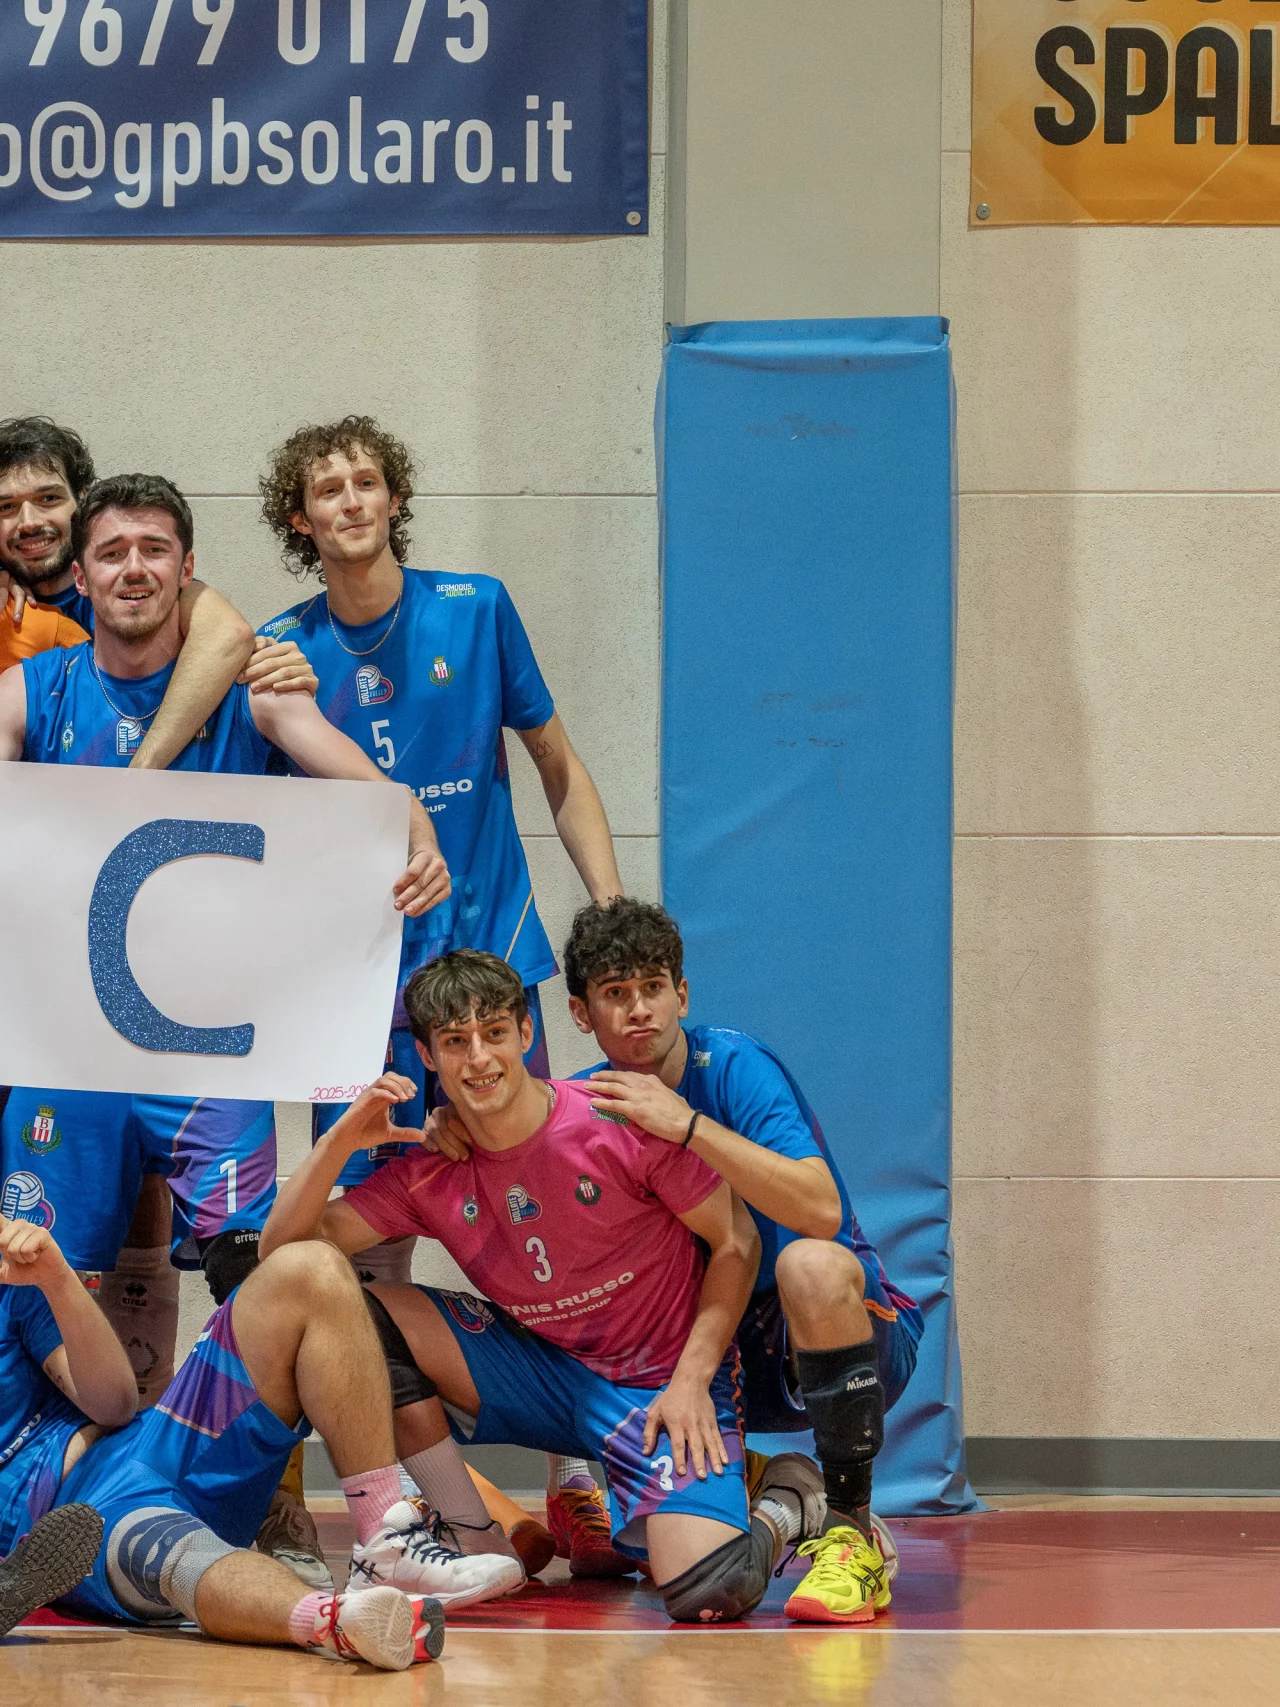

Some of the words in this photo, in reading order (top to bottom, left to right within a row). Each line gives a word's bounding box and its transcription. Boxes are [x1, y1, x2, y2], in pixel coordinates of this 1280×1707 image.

[24, 0, 229, 67] 9679
[277, 0, 489, 65] 0175
[436, 583, 472, 592] DESMODUS
[264, 616, 297, 633] DESMODUS
[358, 676, 370, 704] BOLLATE
[119, 727, 128, 753] BOLLATE
[370, 719, 395, 769] 5
[412, 779, 473, 800] USSO
[424, 803, 447, 813] OUP
[87, 818, 266, 1058] C
[39, 1118, 49, 1130] B
[219, 1159, 238, 1214] 1
[1, 1186, 20, 1221] OLLATE
[508, 1194, 522, 1222] BOLLATE
[525, 1236, 553, 1283] 3
[505, 1302, 553, 1316] NIS
[556, 1271, 635, 1310] RUSSO
[522, 1313, 569, 1327] SINESS
[570, 1297, 612, 1317] GROUP
[650, 1455, 675, 1491] 3
